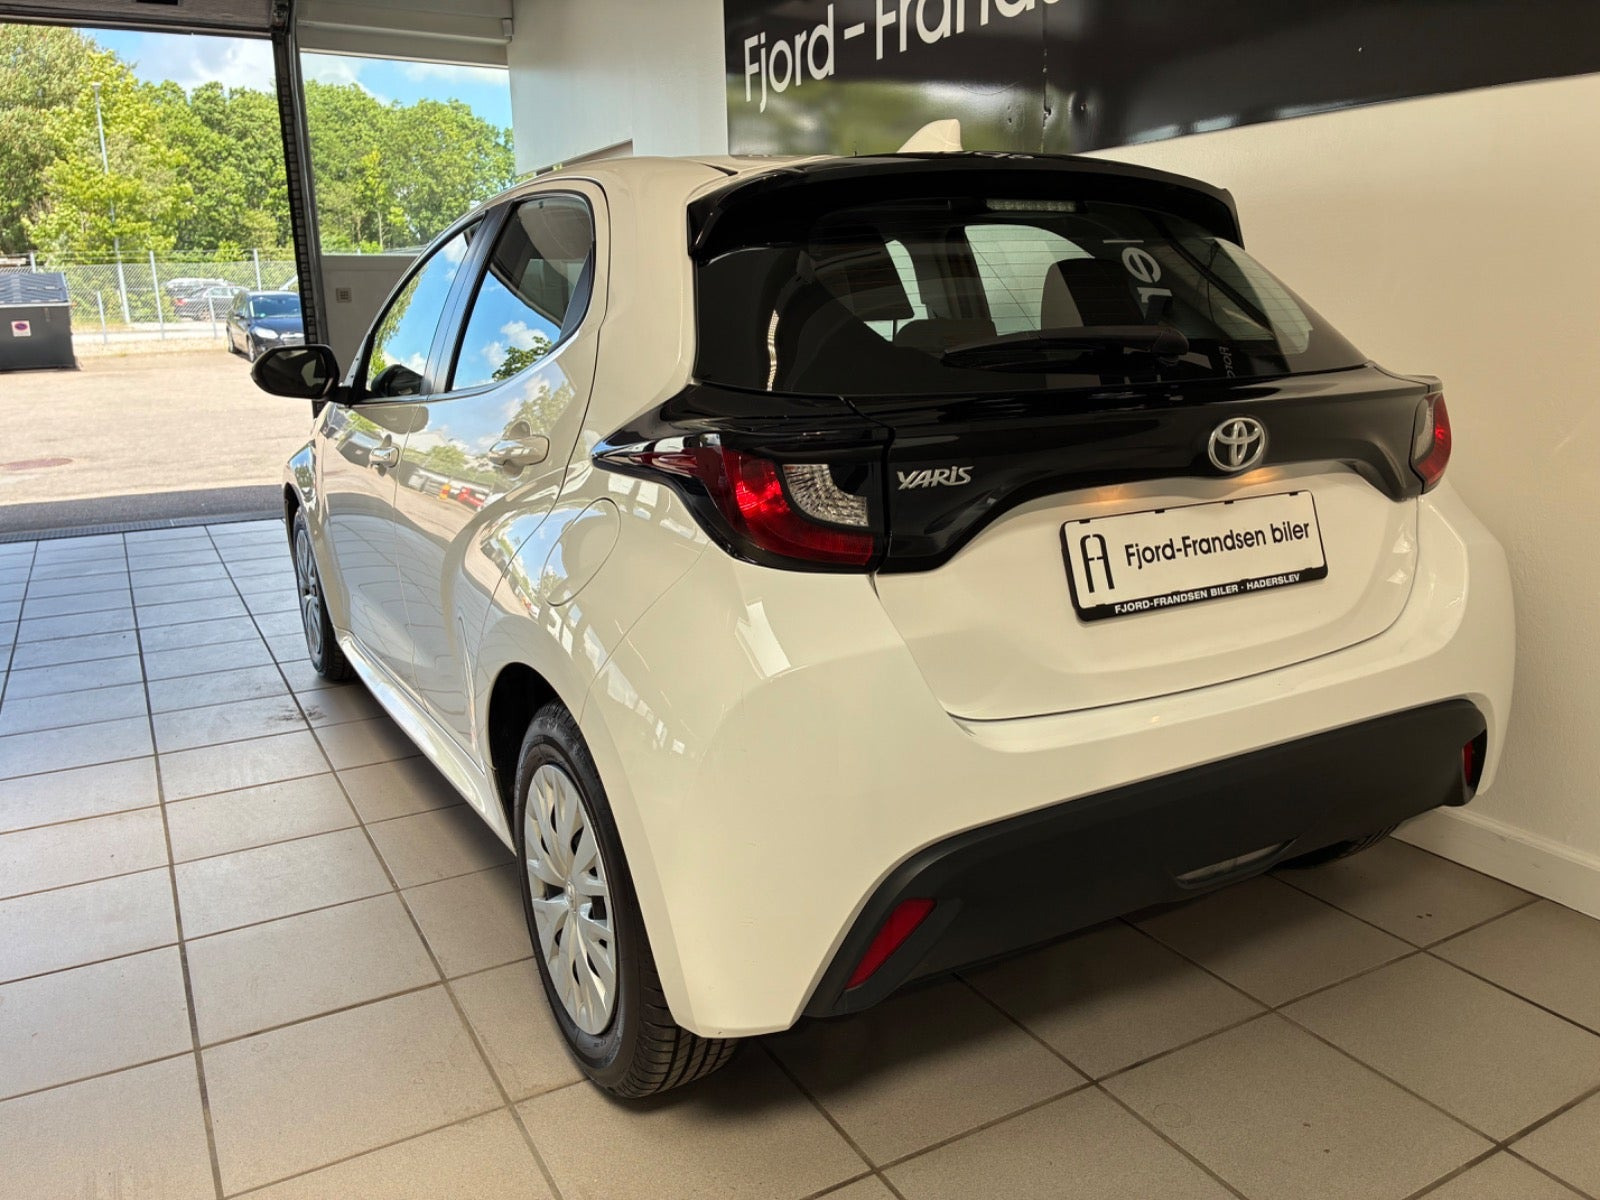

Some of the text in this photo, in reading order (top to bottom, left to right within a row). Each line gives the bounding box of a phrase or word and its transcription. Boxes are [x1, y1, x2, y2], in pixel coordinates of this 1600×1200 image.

[897, 466, 974, 490] YARIS
[1124, 521, 1310, 570] Fjord-Frandsen biler
[1114, 590, 1208, 614] FJORD-FRANDSEN
[1210, 584, 1239, 597] BILER
[1246, 573, 1300, 590] HADERSLEV
